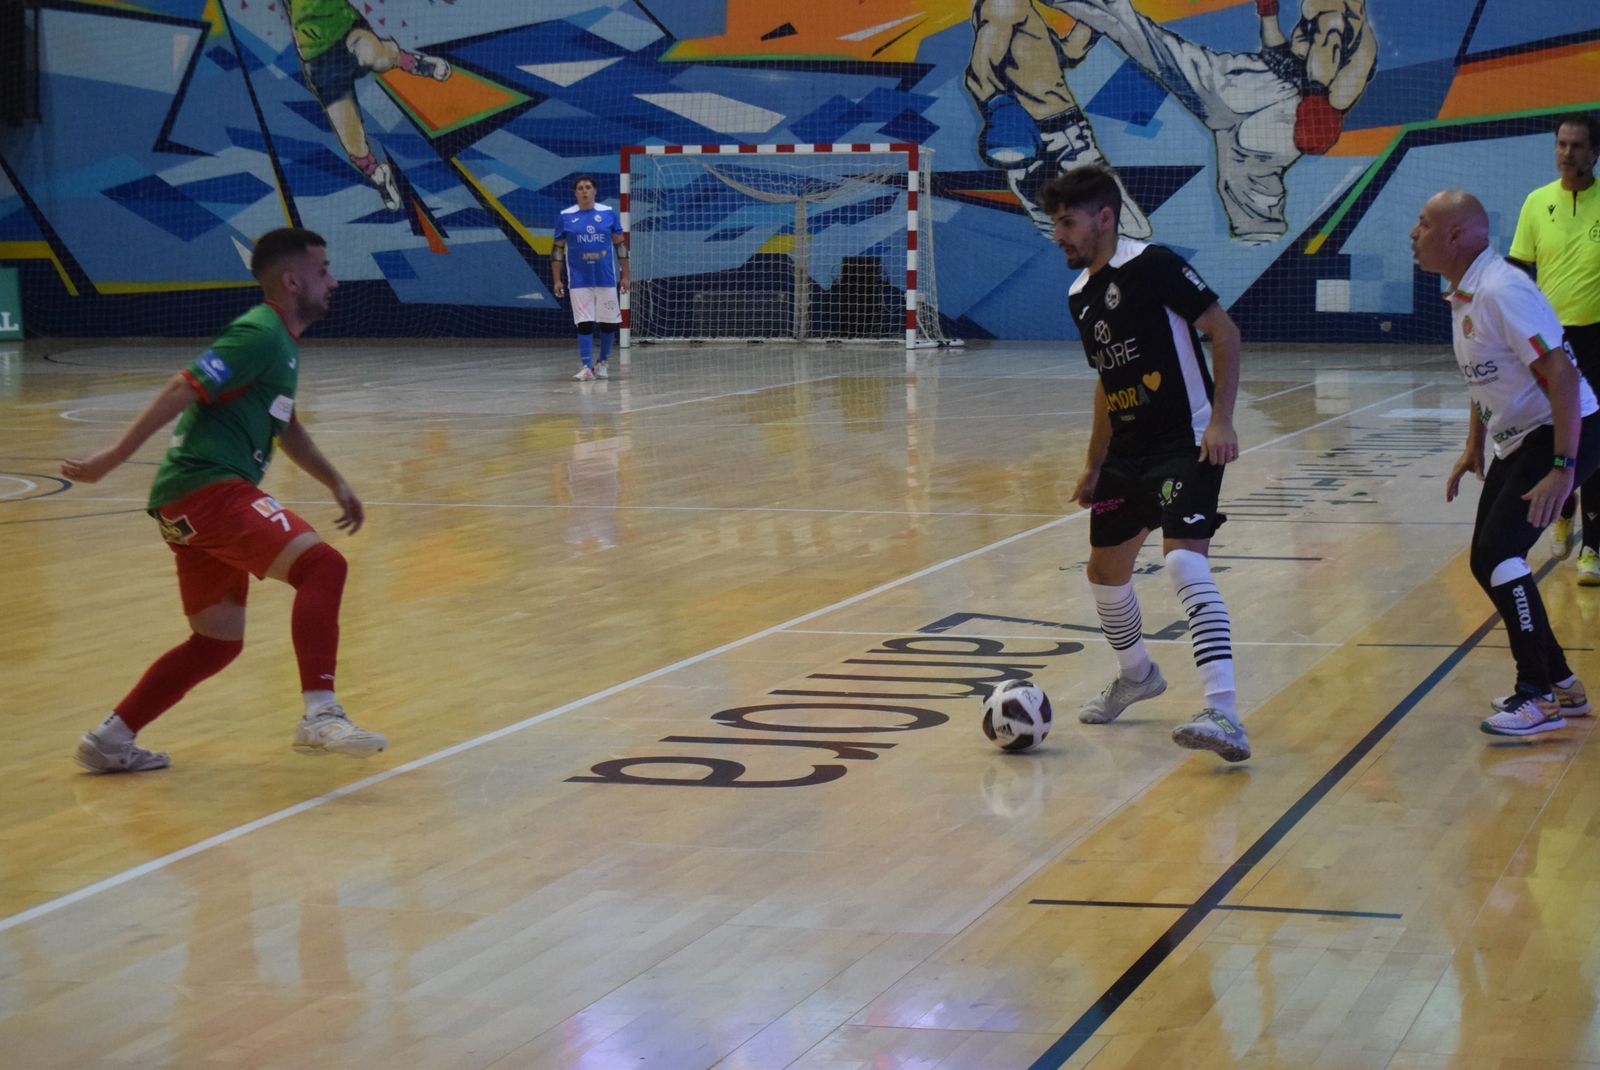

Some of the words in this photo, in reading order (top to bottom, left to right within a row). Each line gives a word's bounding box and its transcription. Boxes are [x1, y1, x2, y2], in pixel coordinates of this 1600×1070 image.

[576, 233, 606, 243] INURE
[1090, 337, 1141, 373] NURE
[269, 512, 291, 532] 7
